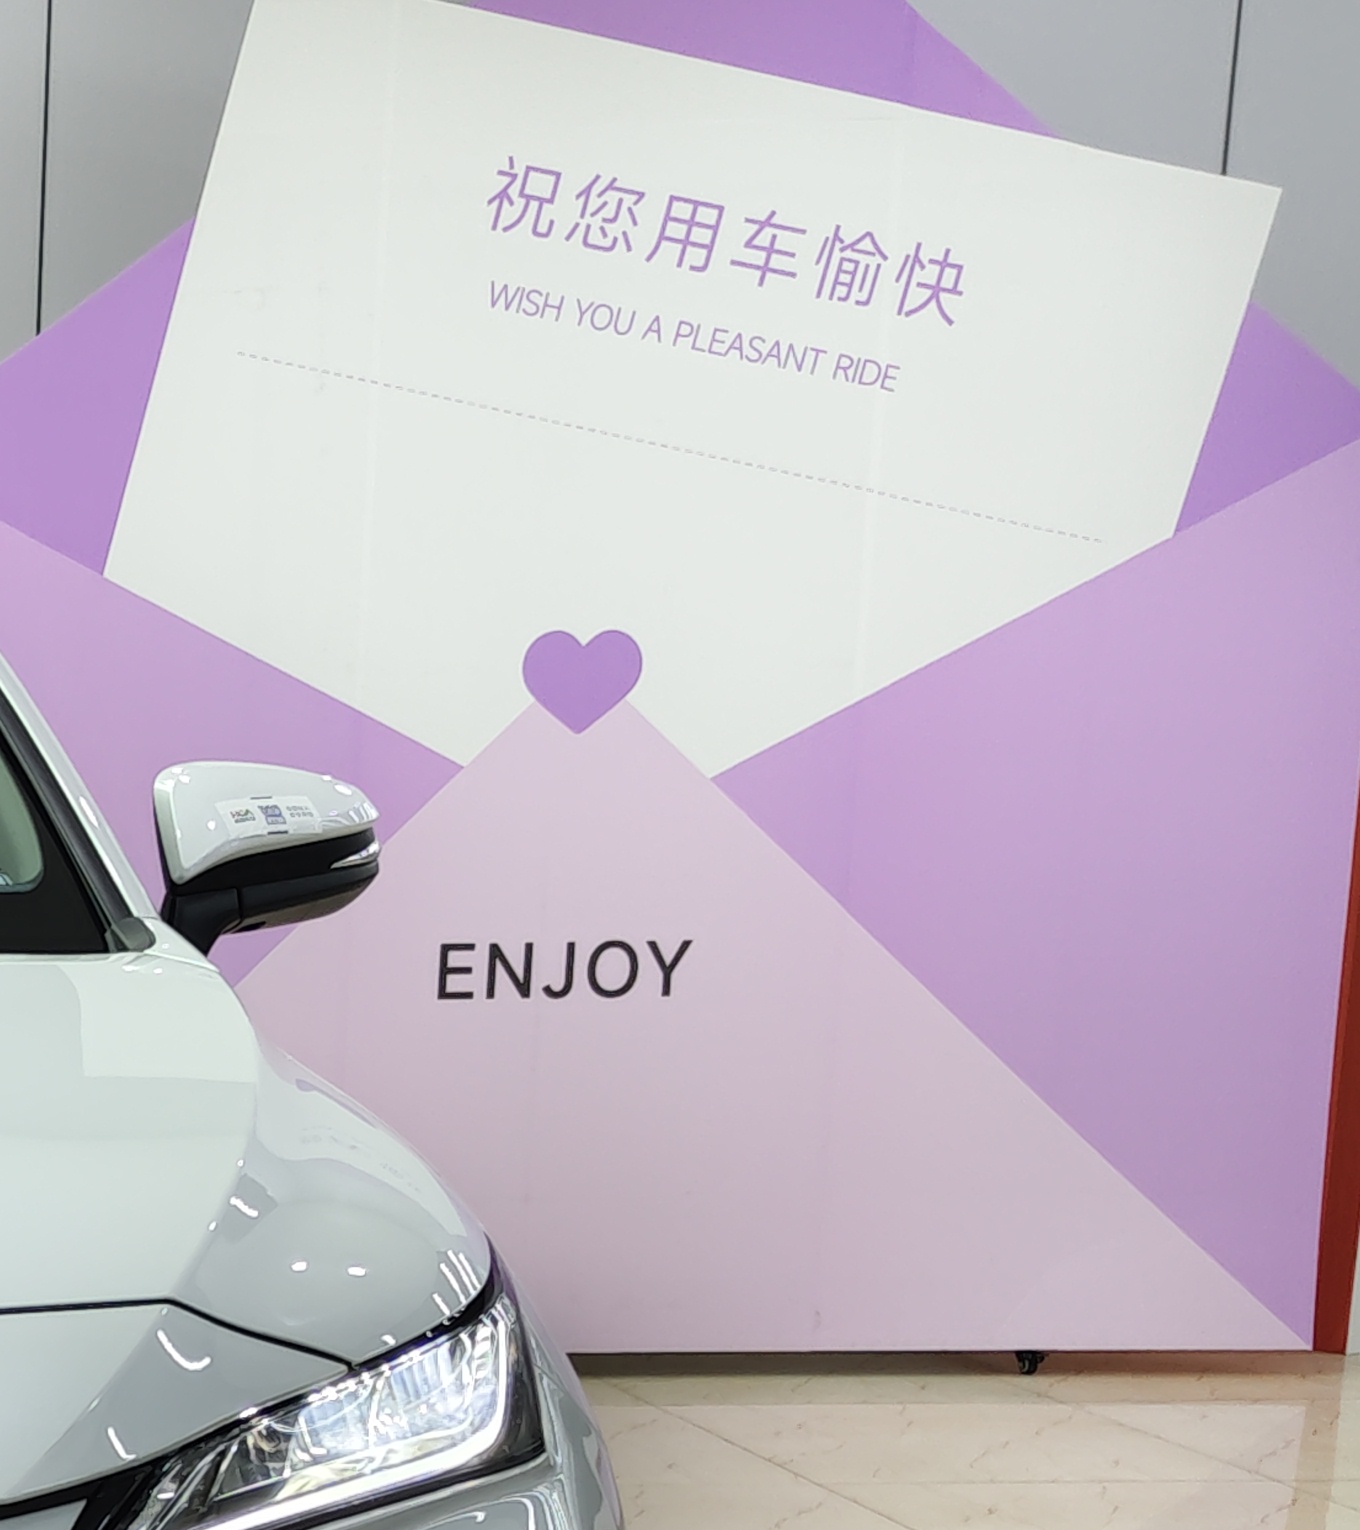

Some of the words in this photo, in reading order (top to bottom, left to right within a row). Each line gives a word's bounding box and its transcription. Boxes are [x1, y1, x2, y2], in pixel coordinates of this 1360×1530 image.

[487, 156, 964, 326] 祝您用车愉快
[489, 280, 565, 323] WISH
[576, 298, 636, 336] YOU
[642, 315, 663, 343] A
[672, 320, 827, 376] PLEASANT
[832, 353, 901, 393] RIDE
[436, 939, 693, 1000] ENJOY
